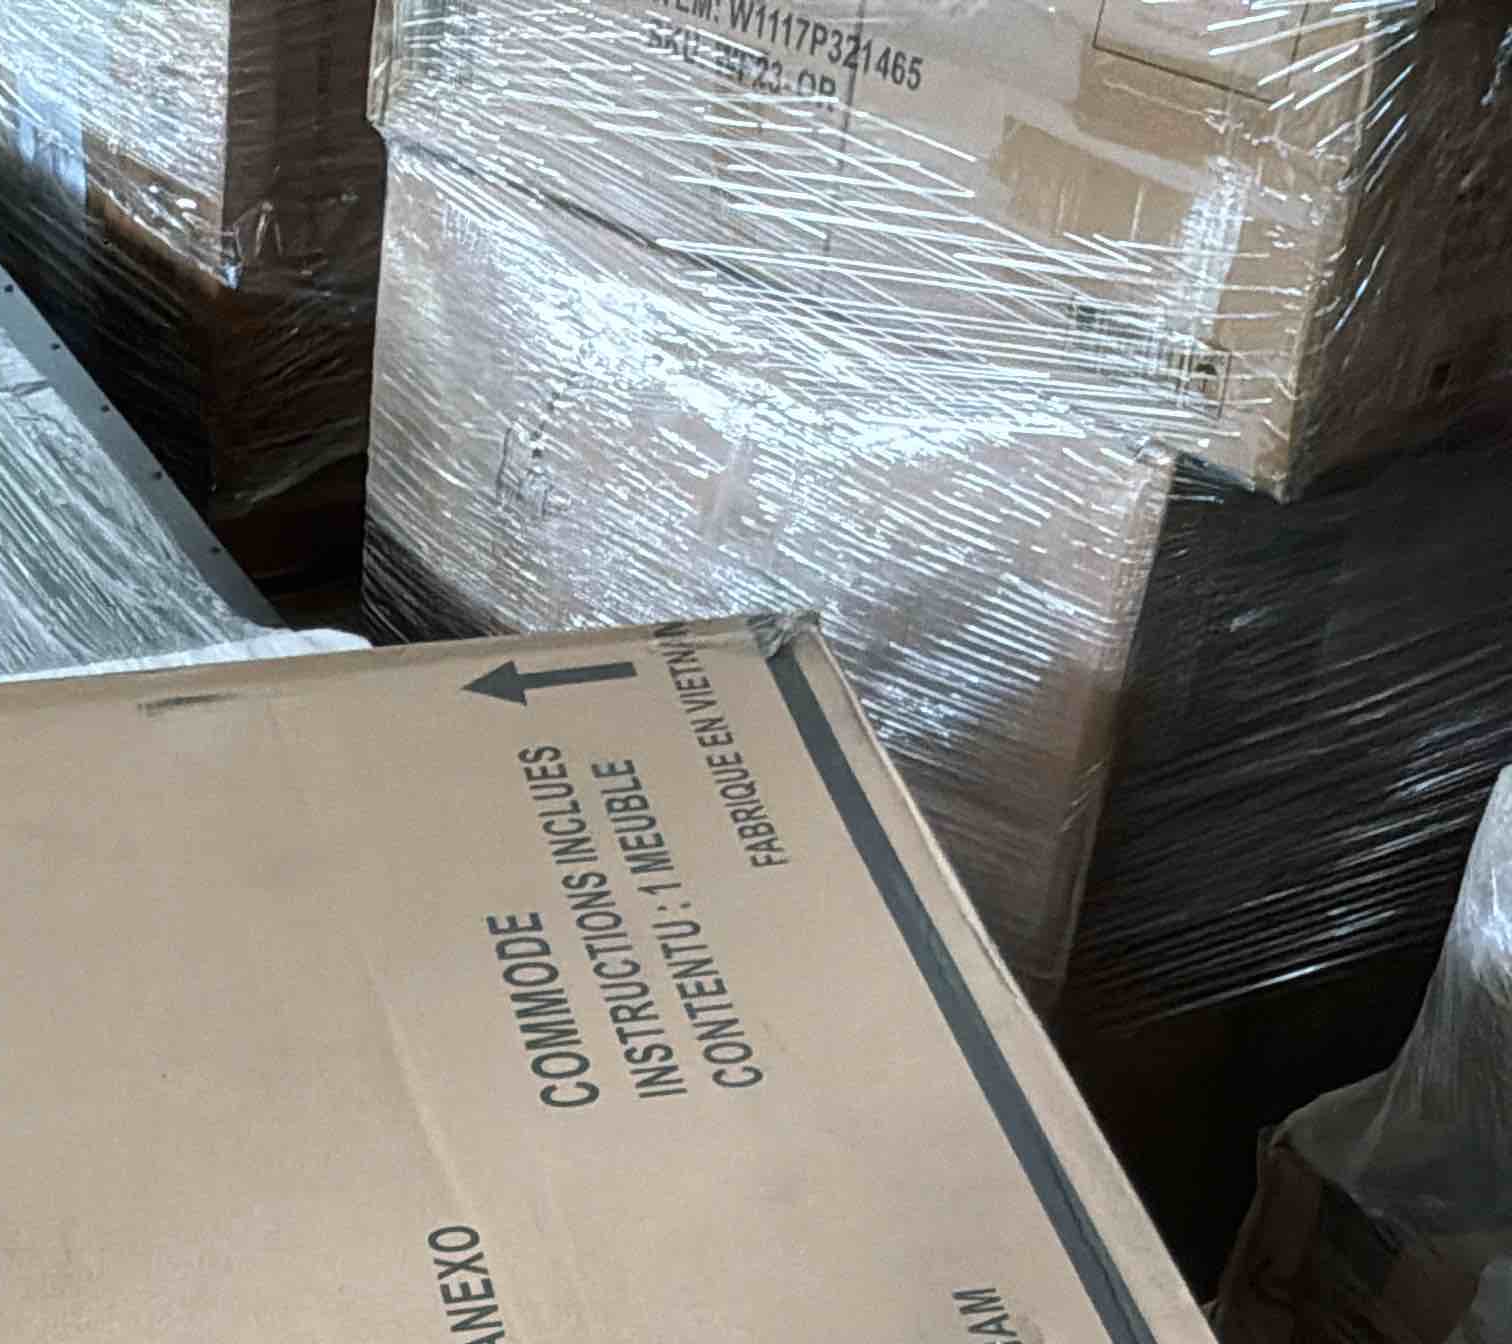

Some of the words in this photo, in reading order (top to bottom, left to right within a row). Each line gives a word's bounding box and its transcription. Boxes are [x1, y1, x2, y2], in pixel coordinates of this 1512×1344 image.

[691, 717, 734, 748] EN
[517, 745, 599, 865] INCLUES
[590, 759, 675, 875] MEUBLE
[706, 752, 788, 868] FABRIQUE
[637, 882, 682, 896] 1
[485, 911, 600, 1108] COMMODE
[561, 871, 688, 1099] INSTRUCTIONS
[653, 920, 764, 1089] CONTENTU
